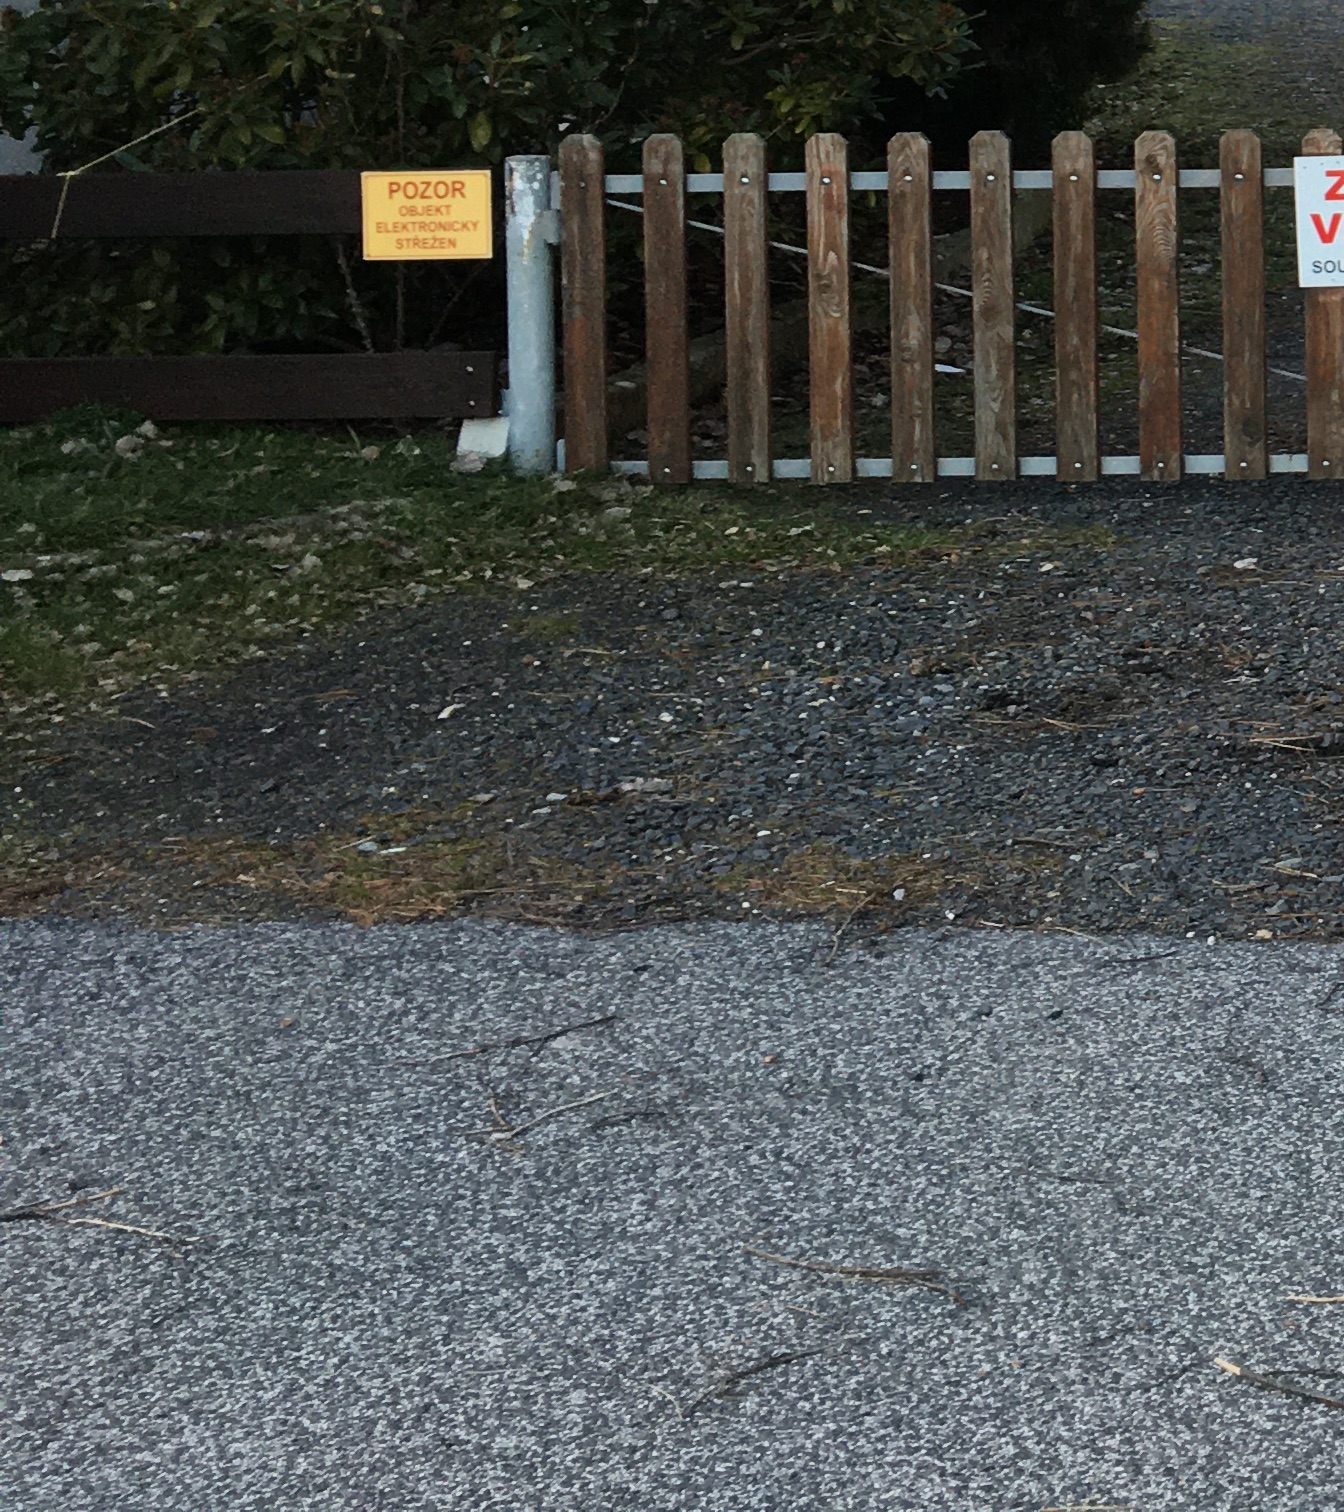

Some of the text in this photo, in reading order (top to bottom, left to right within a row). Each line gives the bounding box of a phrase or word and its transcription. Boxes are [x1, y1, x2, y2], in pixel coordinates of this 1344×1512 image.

[387, 180, 467, 200] POZOR
[398, 204, 452, 217] OBJEKT
[375, 219, 480, 233] ELEKTRONICKY
[395, 235, 458, 251] STŘEŽEN
